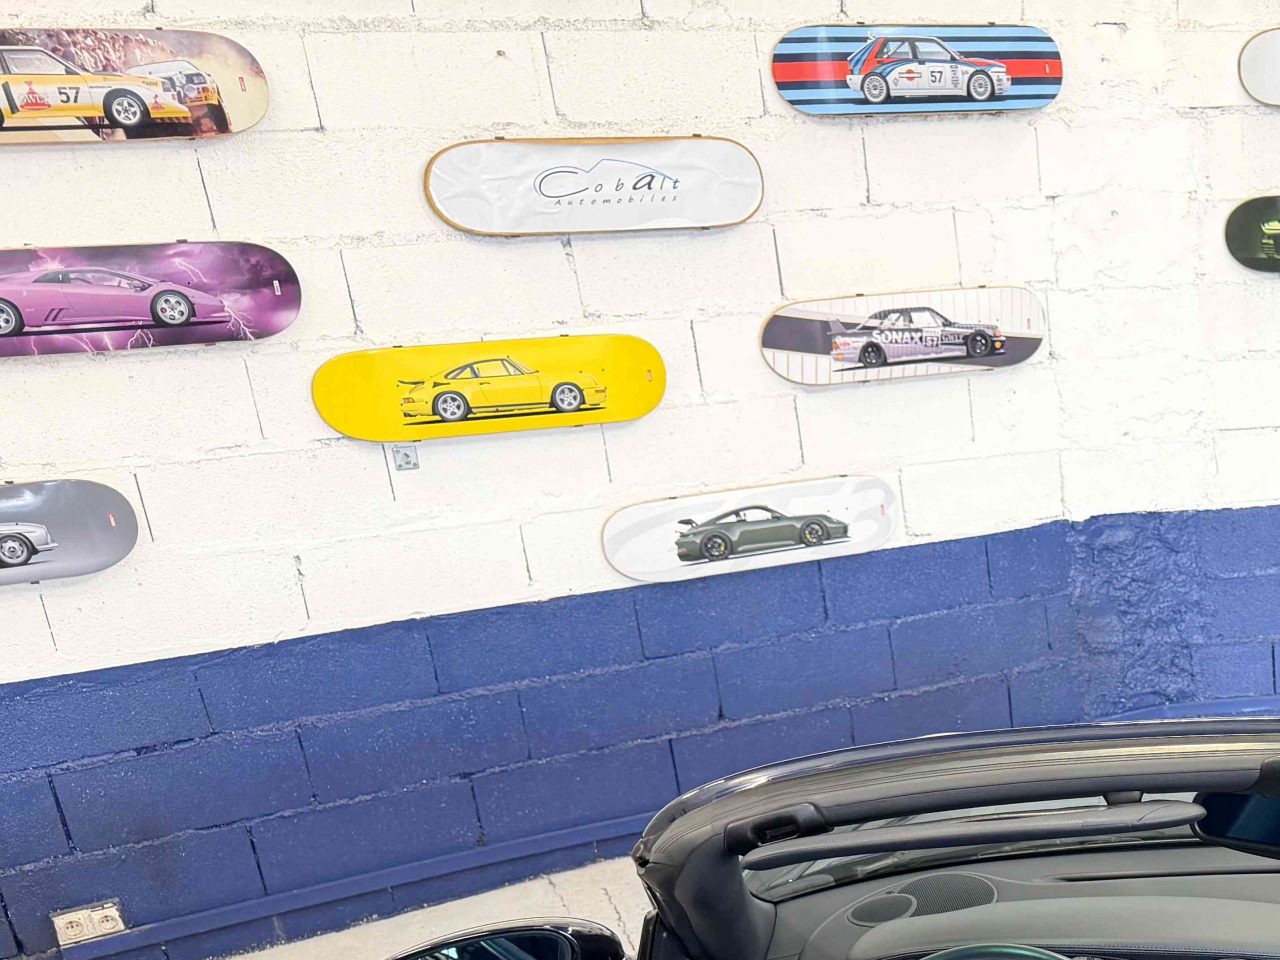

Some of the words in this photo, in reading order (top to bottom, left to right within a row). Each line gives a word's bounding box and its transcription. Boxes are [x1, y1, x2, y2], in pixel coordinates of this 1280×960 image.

[930, 71, 944, 84] 57
[56, 87, 80, 104] 57
[539, 170, 681, 199] Cobalt
[554, 195, 678, 206] Automobiles
[871, 329, 923, 345] SONAX
[924, 336, 940, 348] 57
